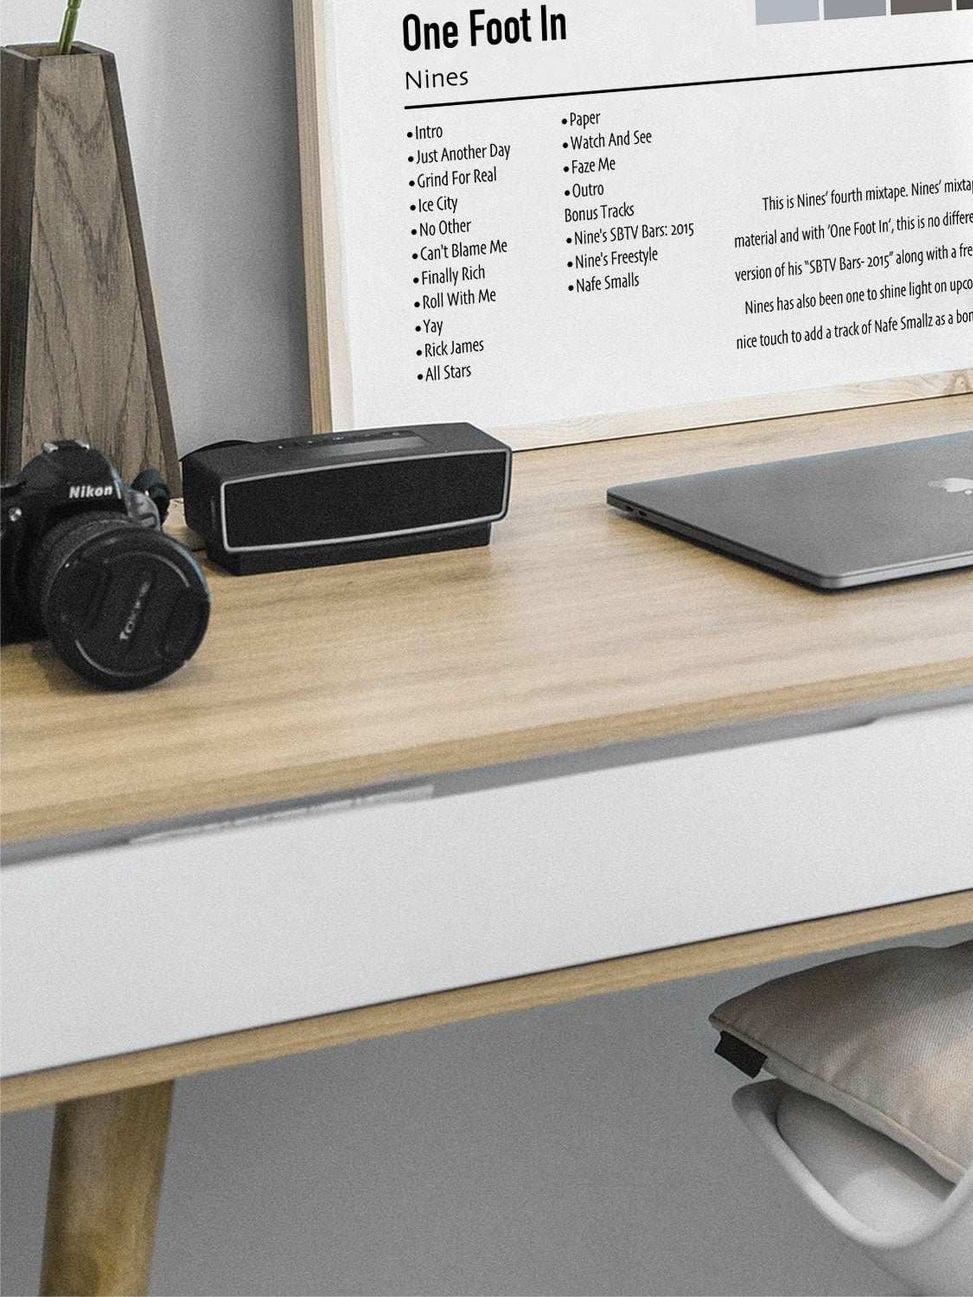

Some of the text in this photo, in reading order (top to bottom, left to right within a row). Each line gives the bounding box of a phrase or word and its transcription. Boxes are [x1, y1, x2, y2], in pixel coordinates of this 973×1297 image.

[403, 5, 566, 51] One Foot In
[406, 69, 468, 89] Nines
[570, 113, 600, 129] Paper
[416, 126, 442, 139] Intro
[570, 130, 652, 149] Watch And See
[416, 144, 510, 164] Just Another Day
[572, 157, 615, 173] Faze Me
[418, 166, 496, 188] Grind For Real
[572, 183, 604, 198] Outro
[762, 196, 784, 211] This
[787, 195, 794, 208] is
[831, 187, 862, 204] fourth
[866, 186, 908, 202] mixtape.
[419, 196, 458, 213] Ice City
[565, 202, 634, 222] Bonus Tracks
[420, 219, 471, 236] No Other
[610, 225, 638, 241] SBTV
[642, 225, 667, 238] Bars:
[672, 223, 694, 236] 2015
[735, 229, 776, 247] material
[780, 227, 798, 243] and
[802, 225, 824, 240] with
[854, 221, 876, 235] Foot
[896, 216, 915, 231] this
[918, 215, 925, 228] is
[928, 217, 940, 227] no
[452, 242, 486, 257] Blame
[490, 239, 507, 253] Me
[612, 247, 658, 266] Freestyle
[735, 266, 772, 281] version
[775, 262, 785, 277] of
[788, 262, 802, 275] his
[896, 249, 923, 266] along
[926, 245, 948, 260] with
[951, 248, 956, 258] a
[422, 264, 485, 286] Finally Rich
[577, 272, 639, 292] Nafe Smalls
[423, 289, 496, 309] Roll With Me
[745, 300, 774, 314] Nines
[777, 297, 794, 311] has
[797, 294, 816, 308] also
[819, 292, 843, 306] been
[846, 291, 864, 303] one
[867, 289, 877, 300] to
[880, 285, 906, 299] shine
[909, 281, 932, 299] light
[935, 282, 946, 293] on
[423, 319, 443, 336] Yay
[737, 335, 757, 349] nice
[760, 330, 788, 346] touch
[791, 331, 802, 343] to
[804, 325, 822, 341] add
[826, 329, 831, 339] a
[834, 321, 859, 337] track
[862, 319, 872, 334] of
[875, 317, 898, 333] Nafe
[901, 313, 933, 330] Smallz
[935, 315, 945, 326] as
[948, 314, 953, 324] a
[425, 340, 484, 357] Rick James
[426, 365, 471, 381] All Stars
[68, 485, 113, 499] Nikon
